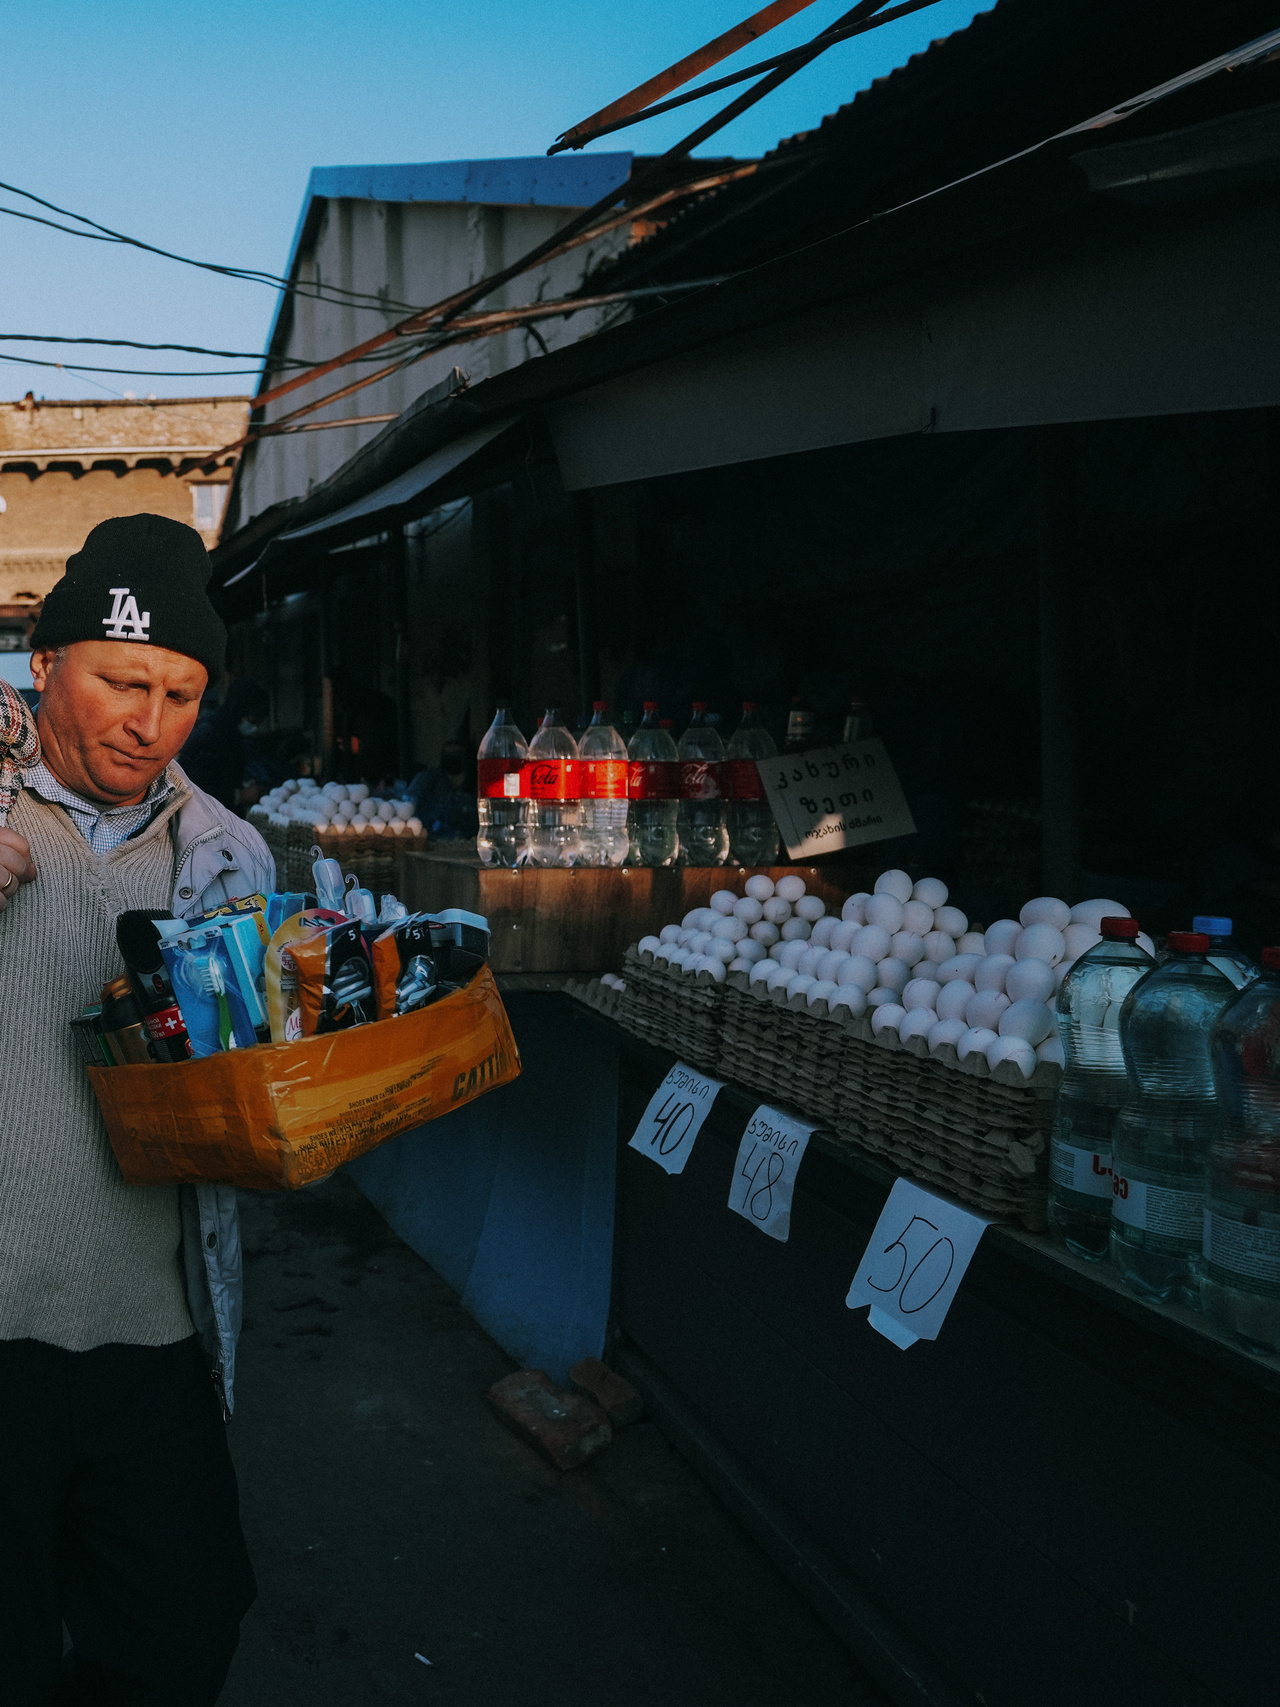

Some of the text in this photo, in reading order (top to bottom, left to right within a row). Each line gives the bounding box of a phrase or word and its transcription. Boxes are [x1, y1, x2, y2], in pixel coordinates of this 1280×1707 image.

[102, 588, 150, 641] LA
[800, 789, 874, 814] ზეთი
[652, 1092, 695, 1155] 40
[741, 1142, 785, 1221] 48
[867, 1215, 955, 1314] 50
